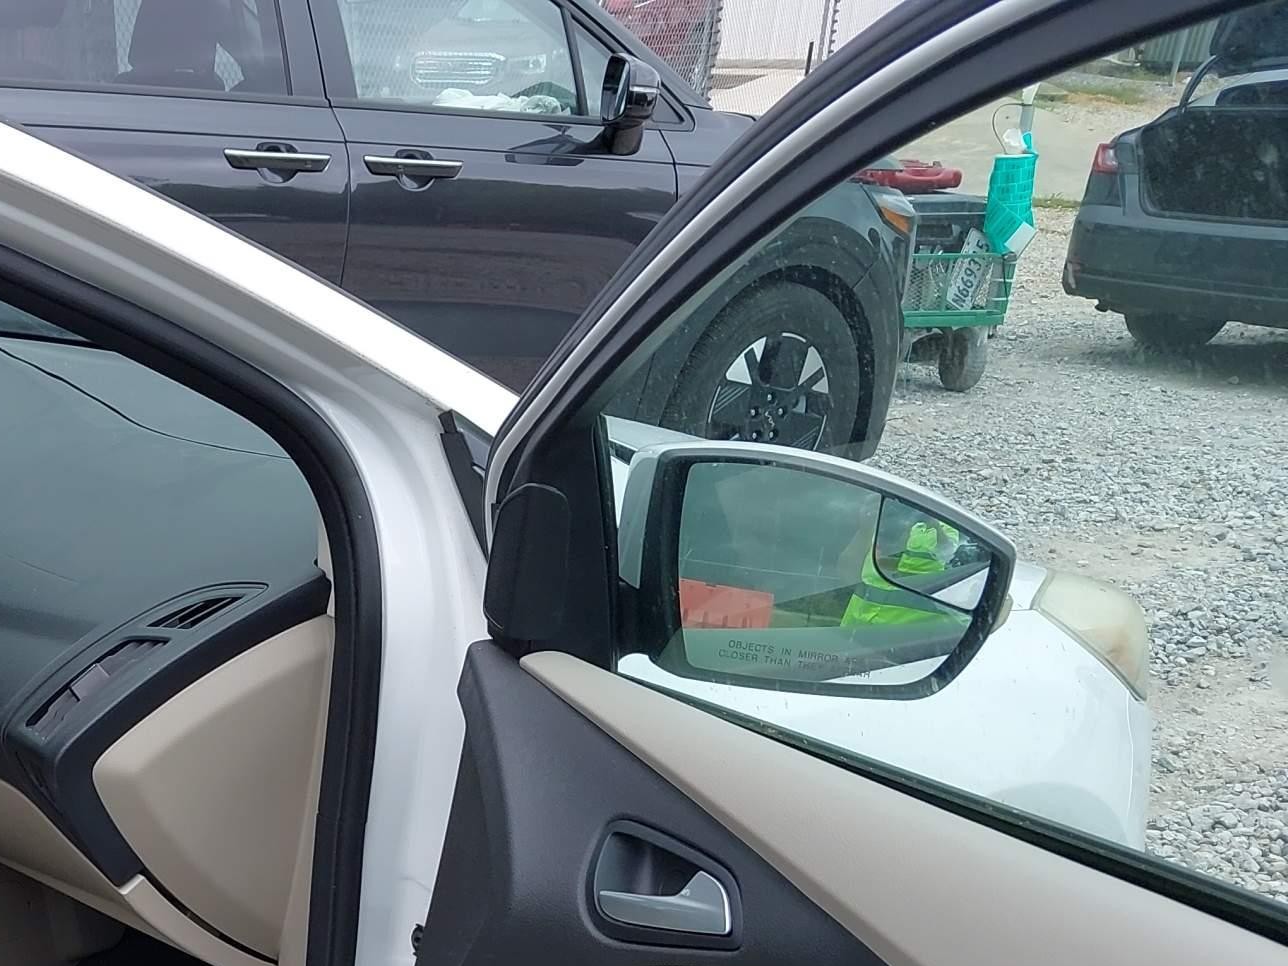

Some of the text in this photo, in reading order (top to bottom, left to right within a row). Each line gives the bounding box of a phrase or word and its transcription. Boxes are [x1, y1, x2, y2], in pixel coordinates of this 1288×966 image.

[951, 239, 990, 307] N66935
[718, 649, 758, 662] CLOSER
[764, 655, 791, 666] THAN
[728, 639, 775, 654] OBJECTS
[781, 647, 792, 656] IN
[798, 650, 838, 662] MIRROR
